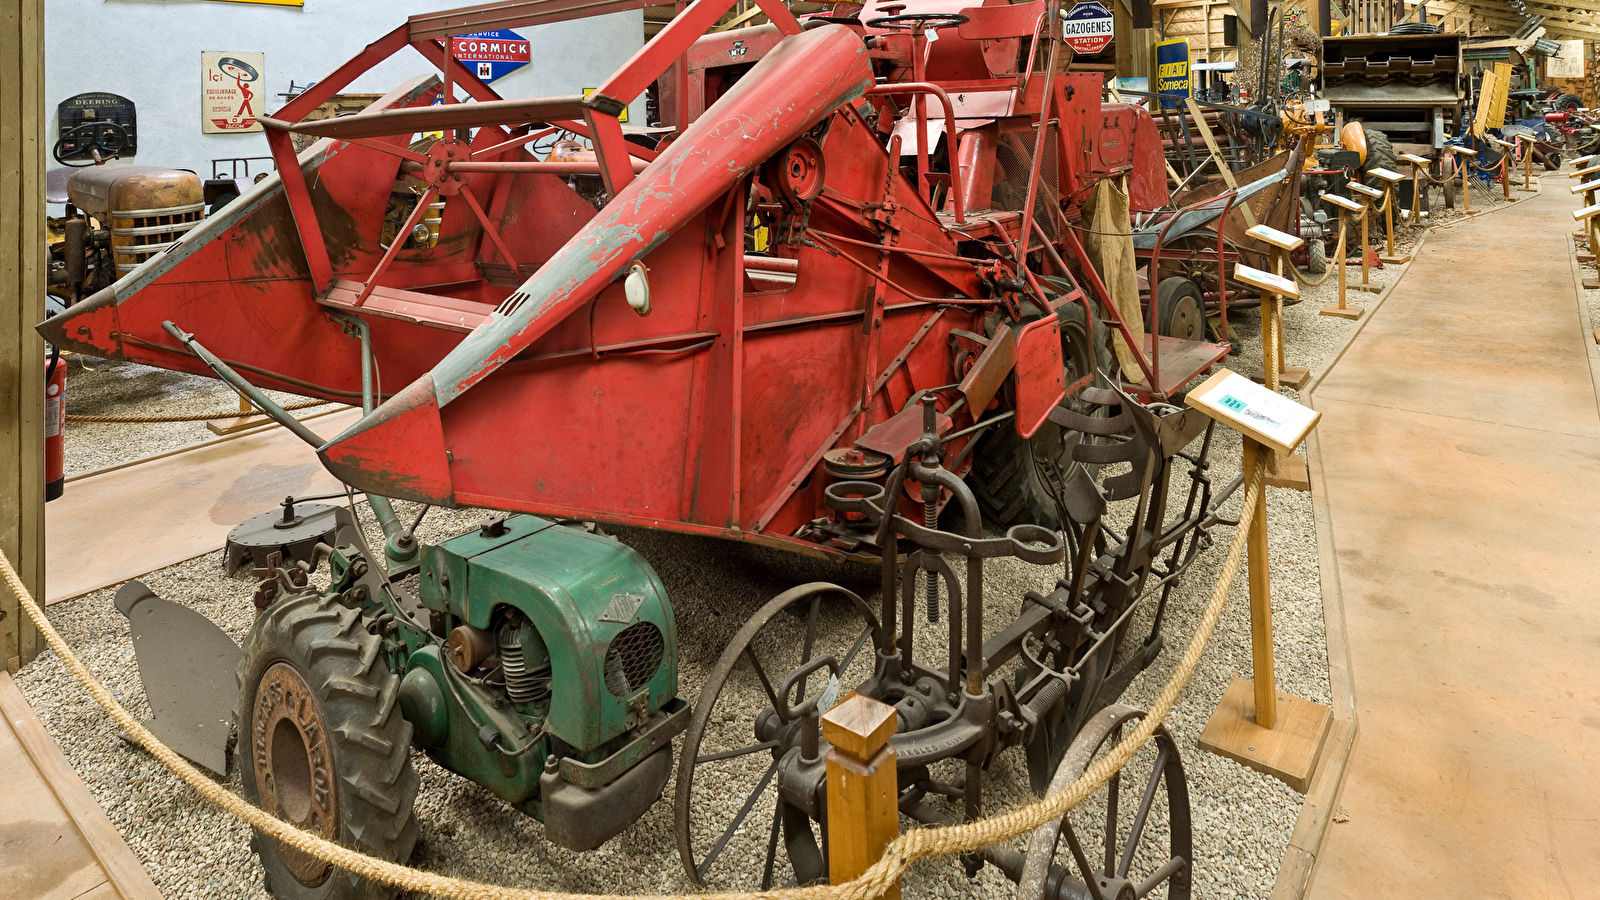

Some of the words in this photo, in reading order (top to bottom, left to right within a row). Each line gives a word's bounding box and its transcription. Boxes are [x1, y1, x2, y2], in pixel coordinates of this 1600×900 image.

[1065, 20, 1112, 35] GAZOGENES
[1073, 37, 1104, 45] STATION
[1159, 63, 1186, 77] FIAT
[1158, 78, 1189, 92] Someca
[297, 694, 329, 811] LABOR
